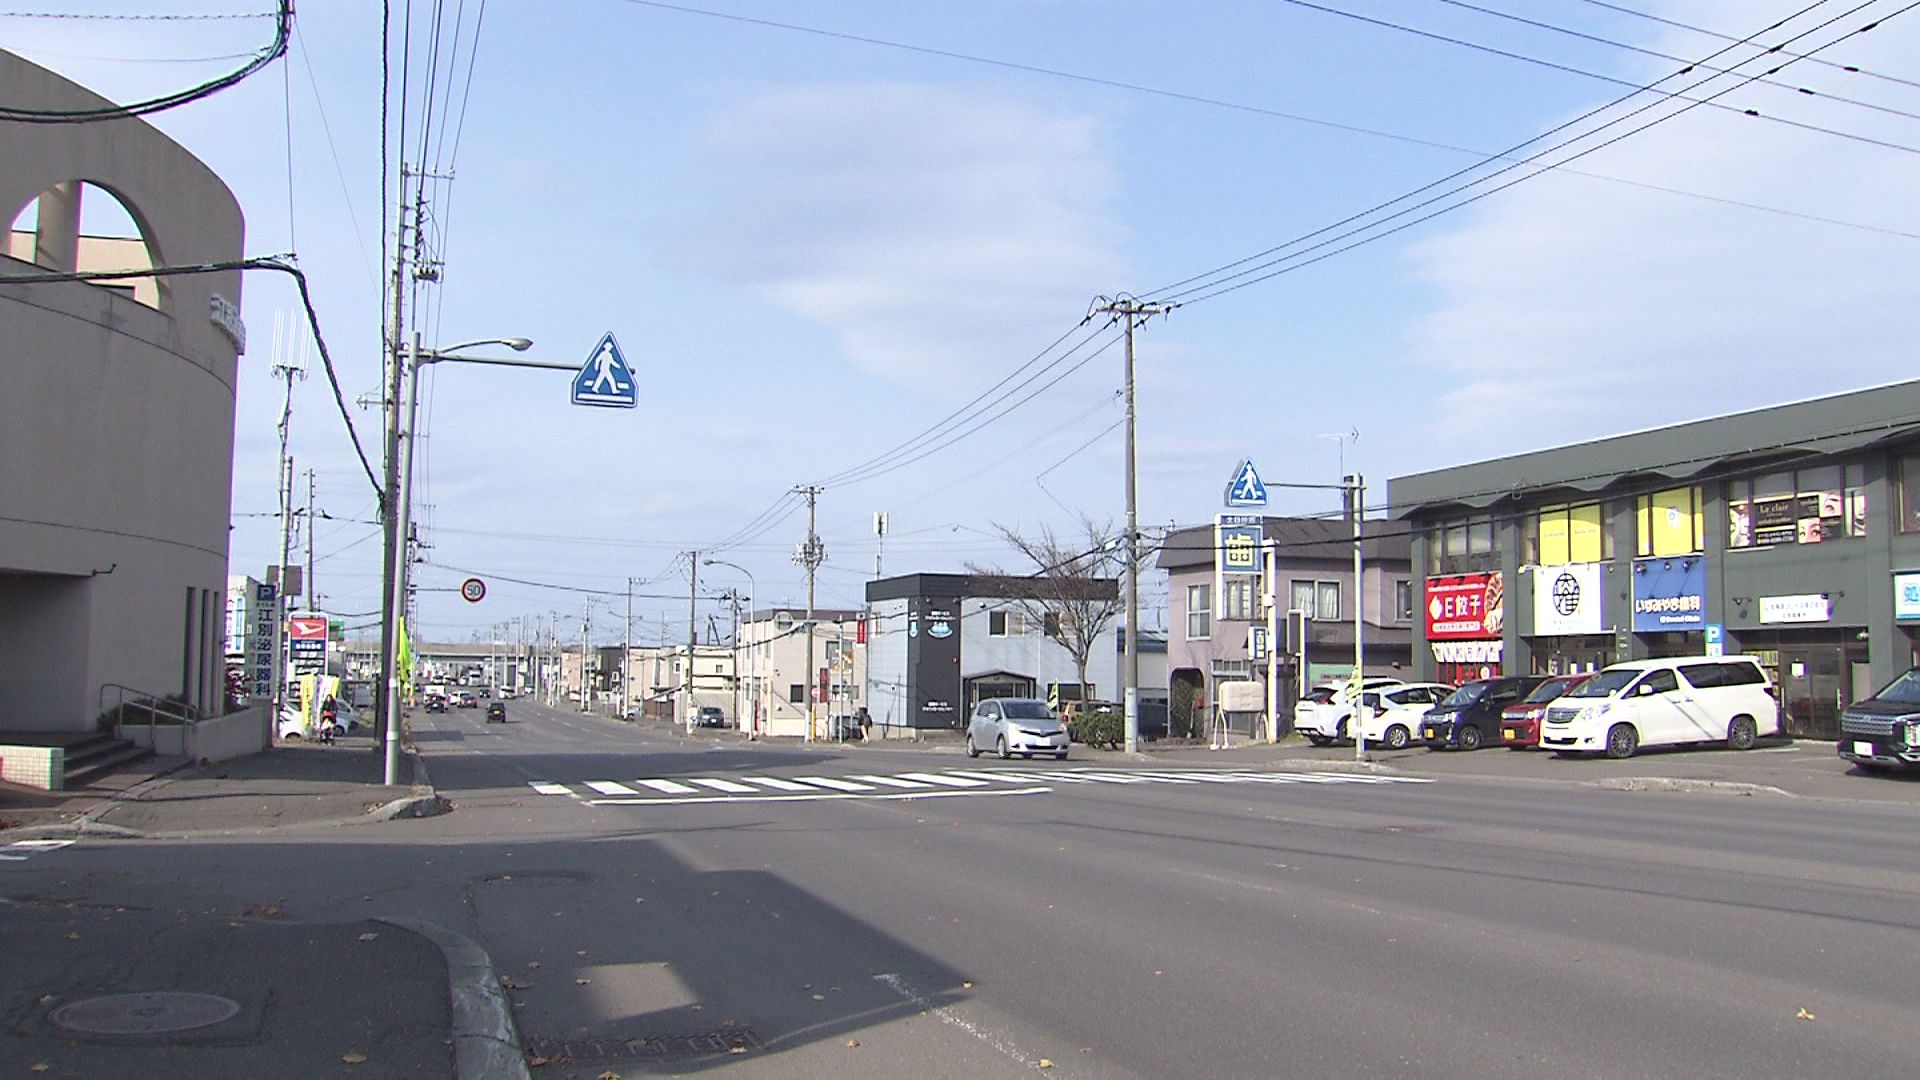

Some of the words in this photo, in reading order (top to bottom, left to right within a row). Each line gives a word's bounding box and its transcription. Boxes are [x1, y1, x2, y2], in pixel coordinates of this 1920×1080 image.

[260, 587, 273, 600] P
[466, 584, 481, 596] 50
[1707, 626, 1721, 642] P
[255, 608, 274, 697] 江別泌尿器科
